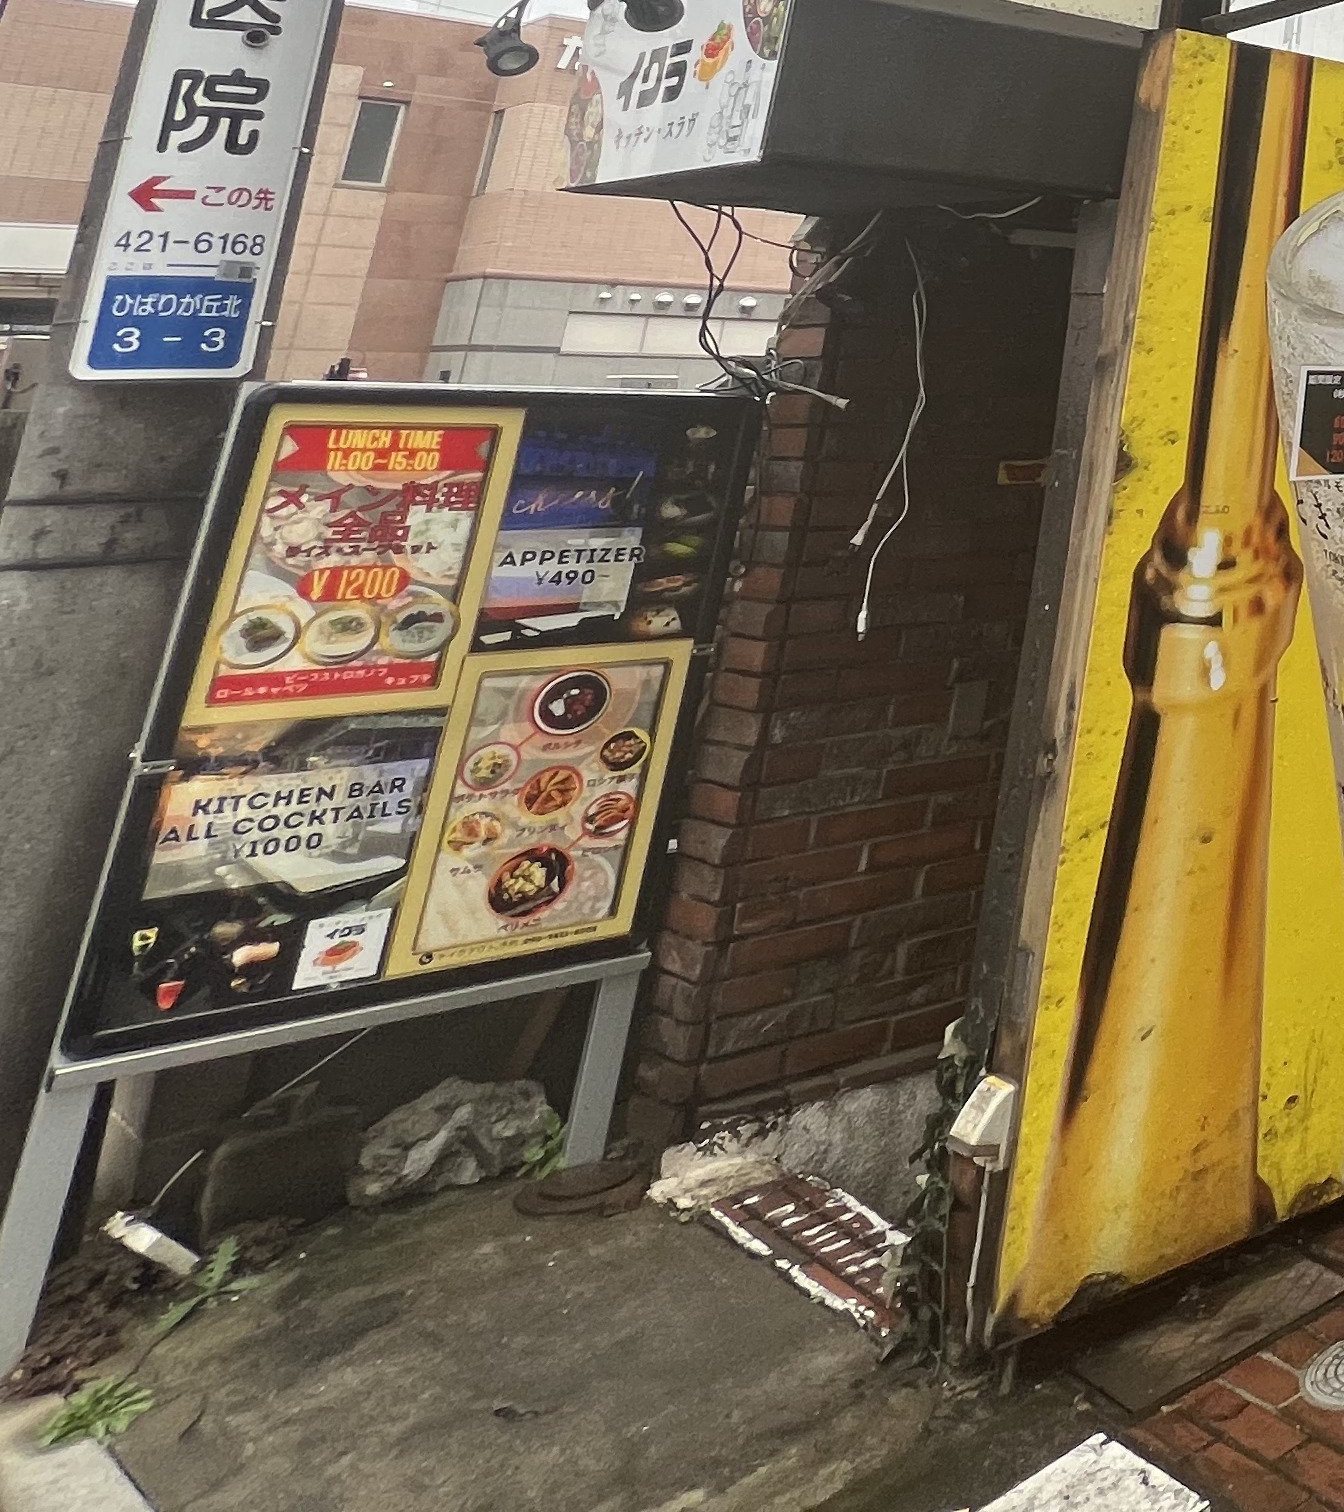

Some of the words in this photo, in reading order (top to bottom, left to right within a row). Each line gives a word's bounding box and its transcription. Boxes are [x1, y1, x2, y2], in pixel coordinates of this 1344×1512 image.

[616, 39, 694, 111] イクラ
[201, 186, 276, 212] この先
[114, 230, 266, 256] 421-6168
[111, 293, 242, 318] ひばりが丘北
[328, 430, 391, 449] LUNCH
[399, 430, 444, 449] TIME
[265, 481, 480, 513] メイン料理
[324, 511, 411, 543] 全品
[498, 547, 645, 567] APPETIZER
[192, 784, 337, 817] KITCHEN
[347, 777, 406, 800] BAR
[159, 822, 219, 845] ALL
[232, 799, 412, 835] COCKTAILS
